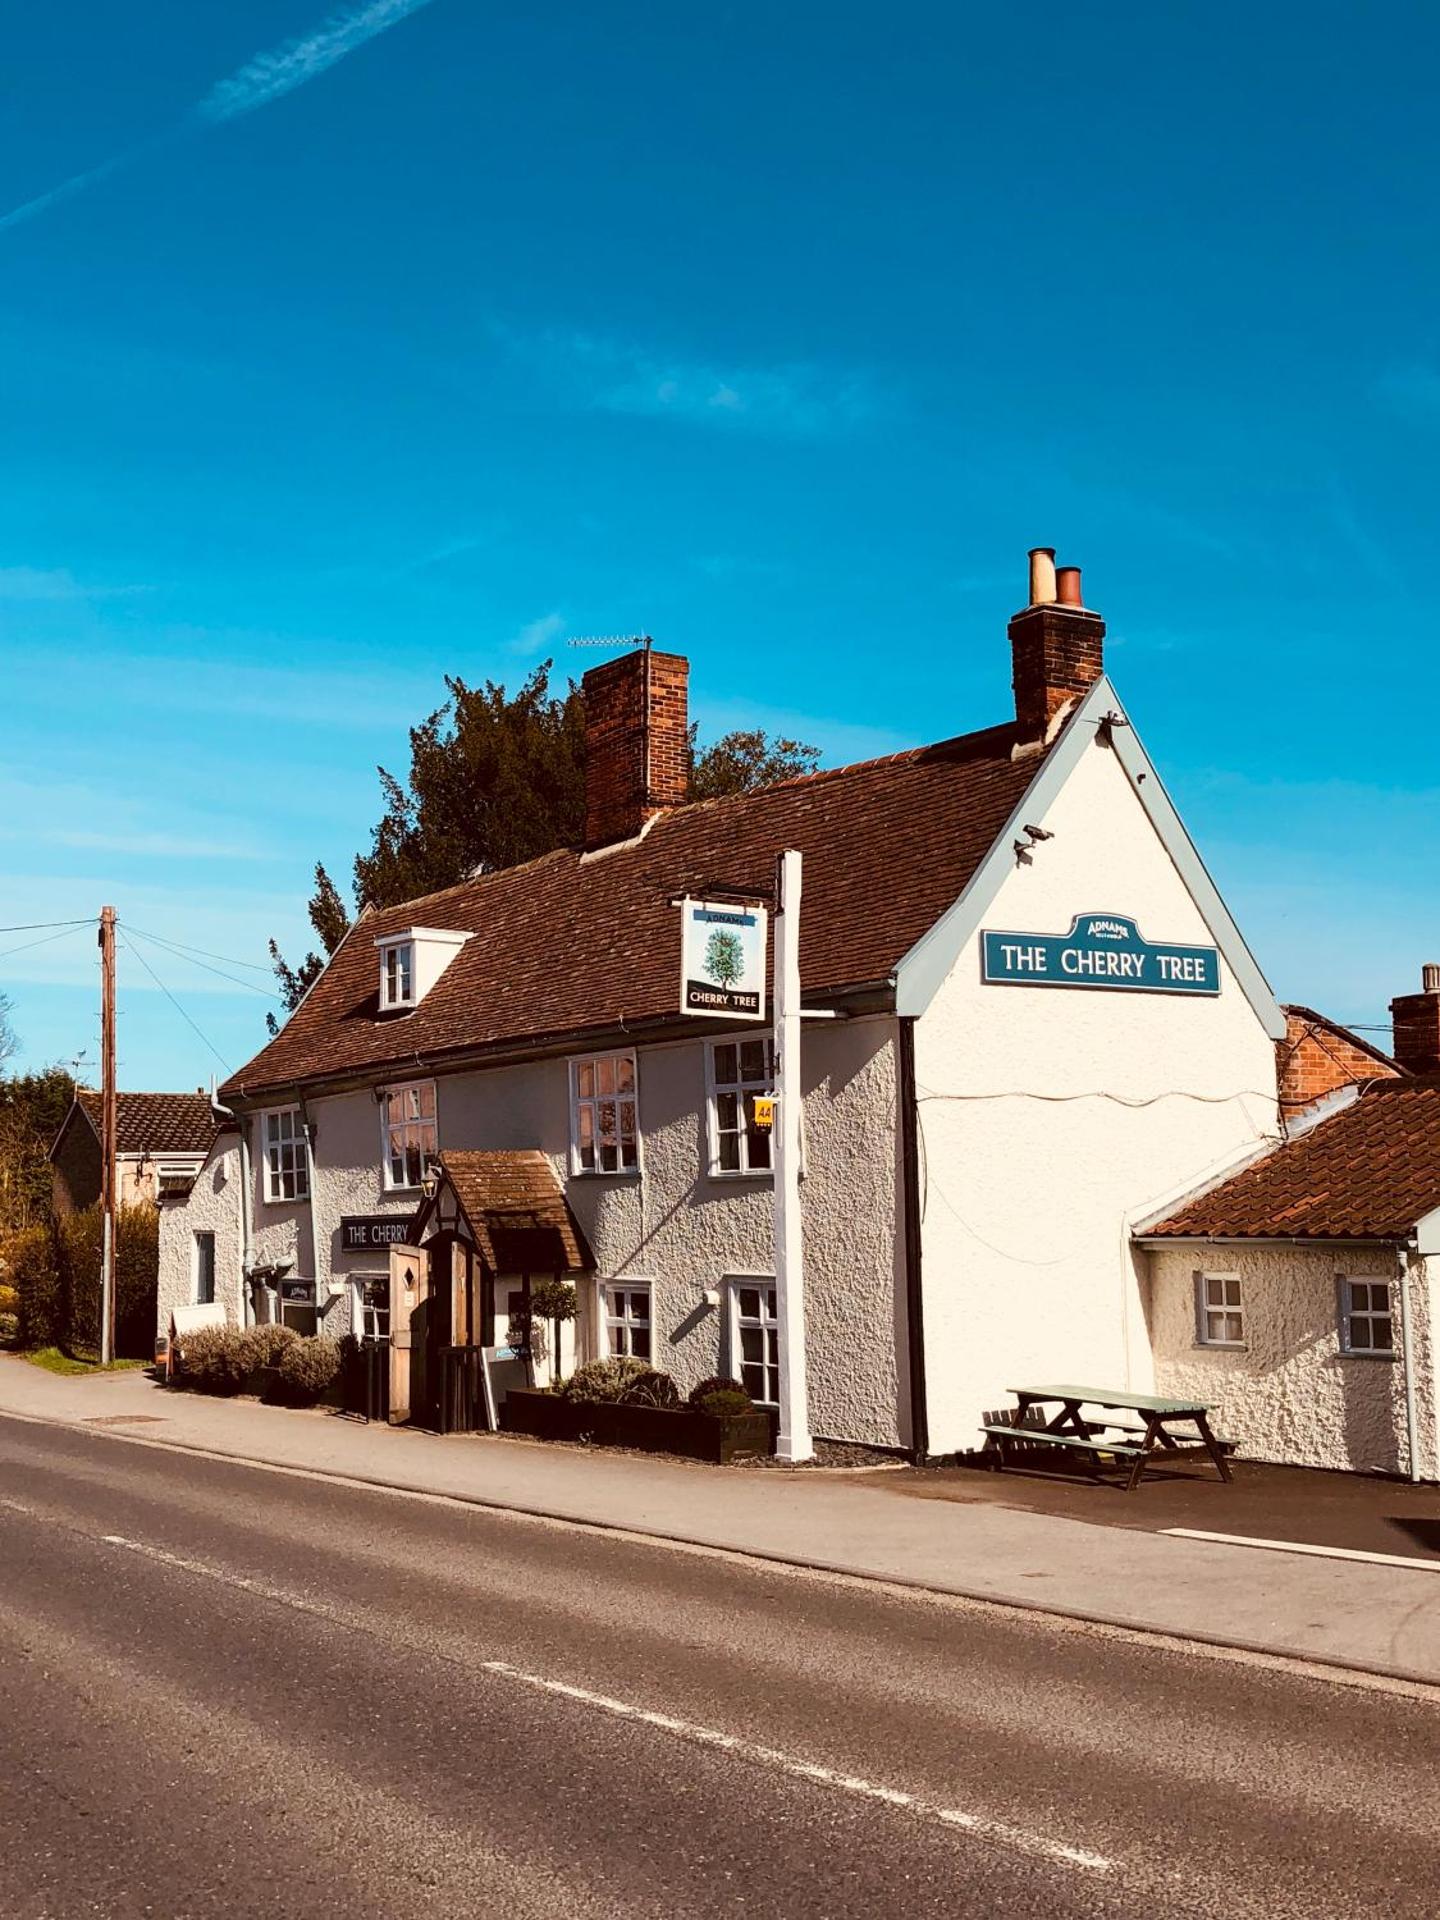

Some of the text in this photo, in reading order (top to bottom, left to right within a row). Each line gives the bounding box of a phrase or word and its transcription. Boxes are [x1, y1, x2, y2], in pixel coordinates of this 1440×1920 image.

[1087, 921, 1130, 938] ADNAMS
[1001, 945, 1205, 982] THE CHERRY TREE
[690, 991, 757, 1007] CHERRY TREE
[348, 1224, 409, 1243] THE CHERRY
